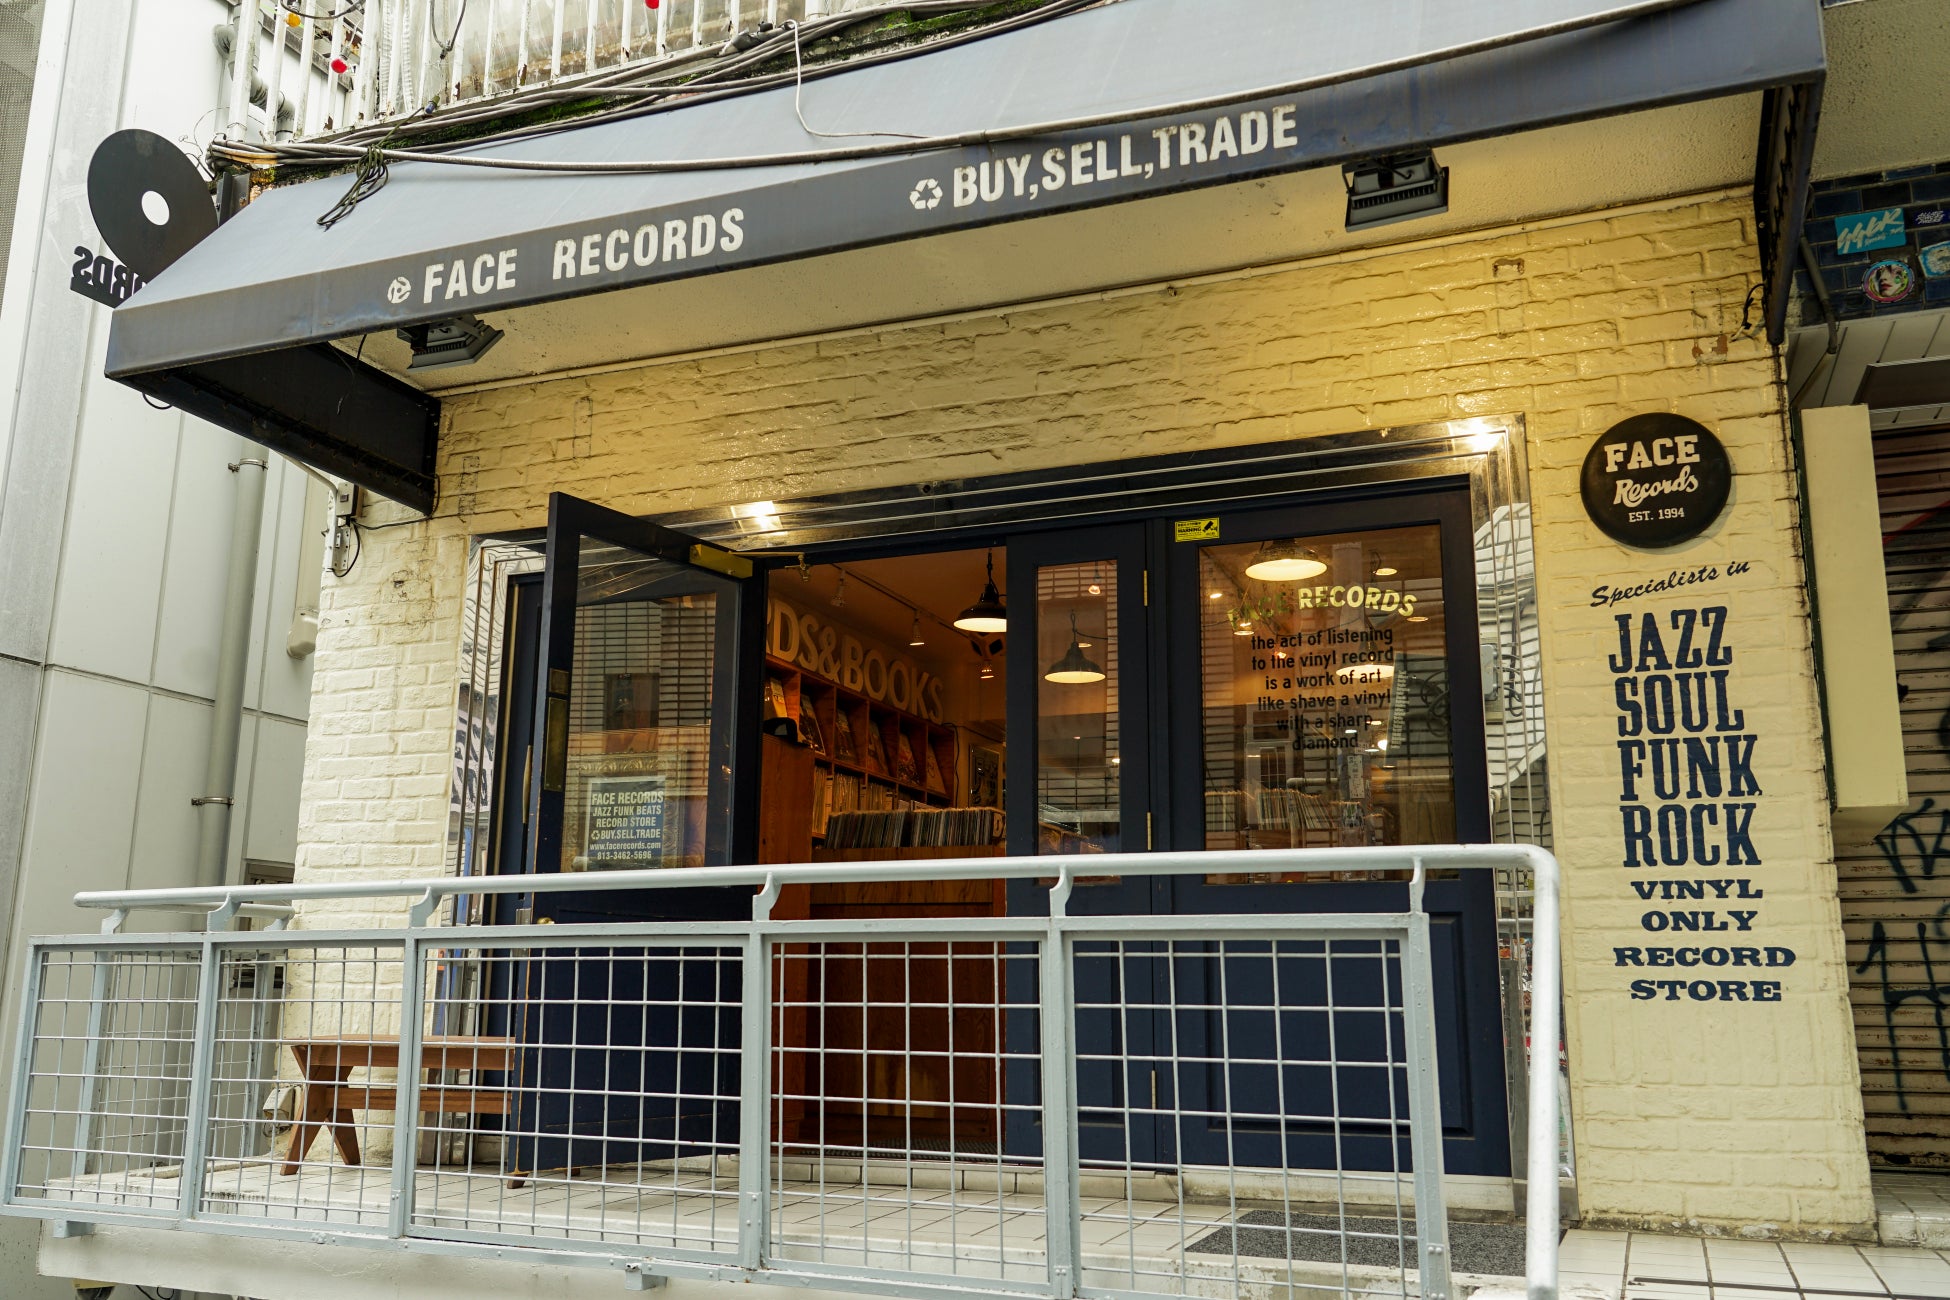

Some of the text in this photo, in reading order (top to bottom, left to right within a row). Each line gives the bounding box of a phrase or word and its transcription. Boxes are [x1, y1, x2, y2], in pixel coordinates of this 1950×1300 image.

[423, 208, 744, 303] FACE RECORDS
[1604, 435, 1701, 472] FACE
[1613, 465, 1699, 508] Records
[1628, 507, 1685, 523] EST. 1994
[1590, 560, 1751, 608] Specialists in
[1298, 585, 1418, 617] RECORDS
[1251, 628, 1393, 650] the act of listening
[1608, 606, 1732, 673] JAZZ
[766, 598, 944, 725] DS&BOOKS
[1252, 646, 1394, 671] to the vinyl record
[1265, 668, 1381, 690] is a work of art
[1258, 688, 1391, 711] like shave a vinyl
[1615, 670, 1744, 737] SOUL
[1276, 712, 1373, 731] with a sharp
[1293, 733, 1358, 751] diamond
[1617, 735, 1762, 801] FUNK
[591, 790, 664, 805] FACE RECORDS
[592, 804, 662, 817] JAZZ FUNK BEATS
[596, 816, 656, 828] RECORD STORE
[589, 841, 661, 851] www.facerecords.com
[1620, 803, 1762, 868] ROCK
[1630, 879, 1763, 900] VINYL
[1641, 910, 1758, 931] ONLY
[1613, 946, 1796, 967] RECORD
[1630, 979, 1782, 1001] STORE
